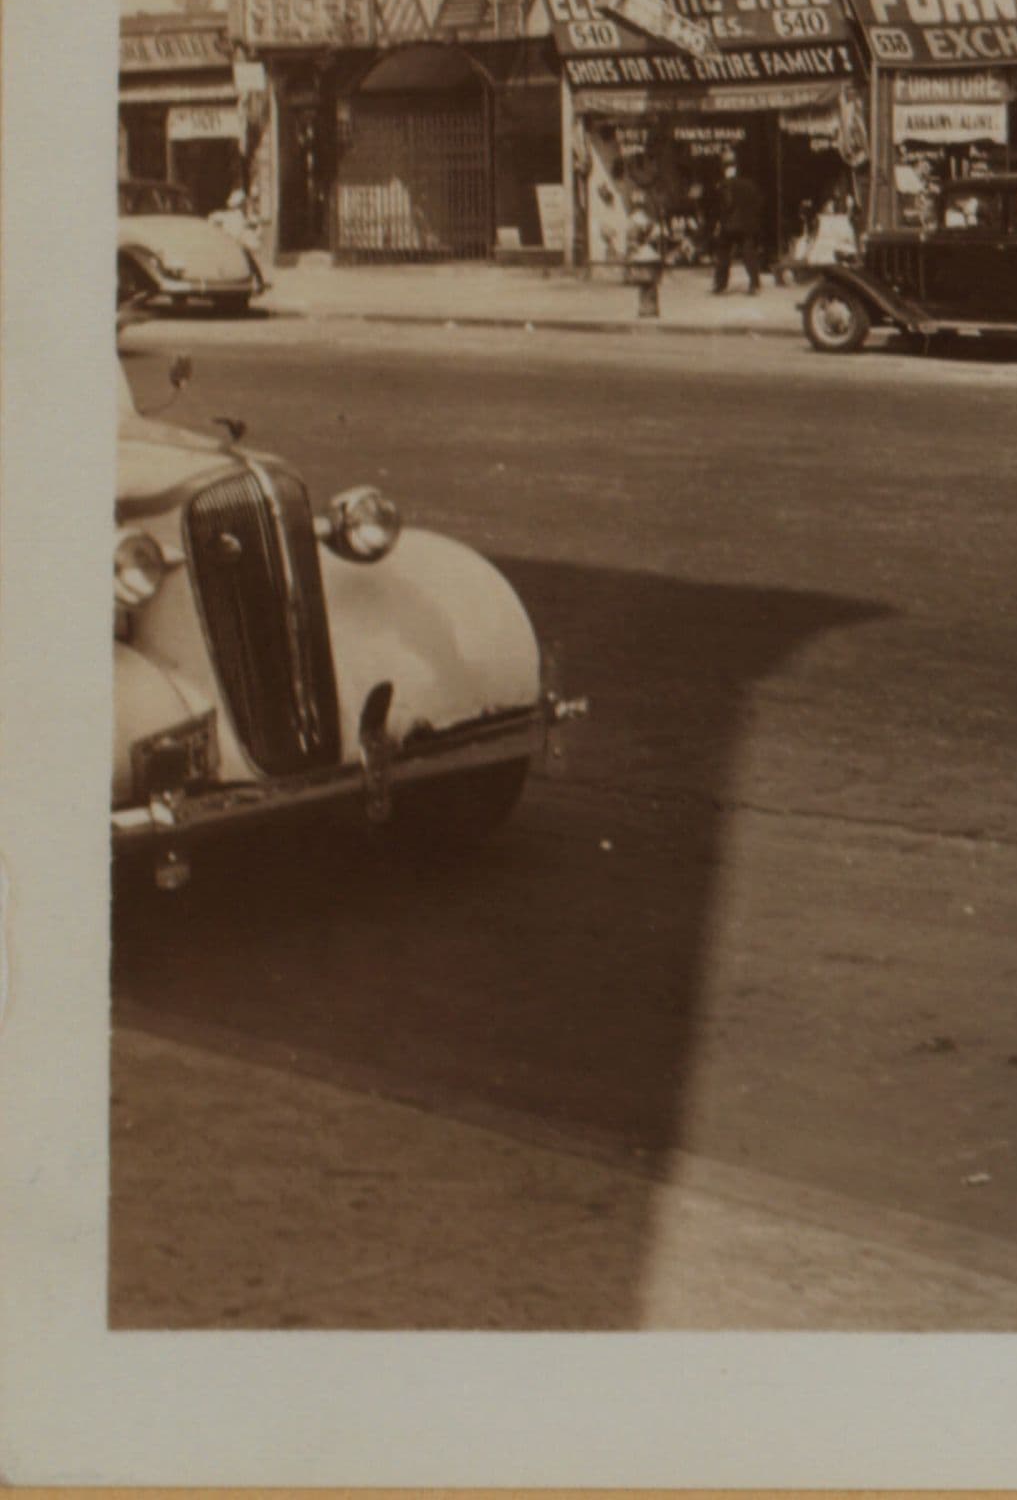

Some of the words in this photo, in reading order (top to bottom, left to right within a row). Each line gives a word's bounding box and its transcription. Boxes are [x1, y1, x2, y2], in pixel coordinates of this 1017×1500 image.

[566, 59, 621, 85] SHOES
[621, 58, 652, 83] FOR
[656, 56, 690, 81] THE
